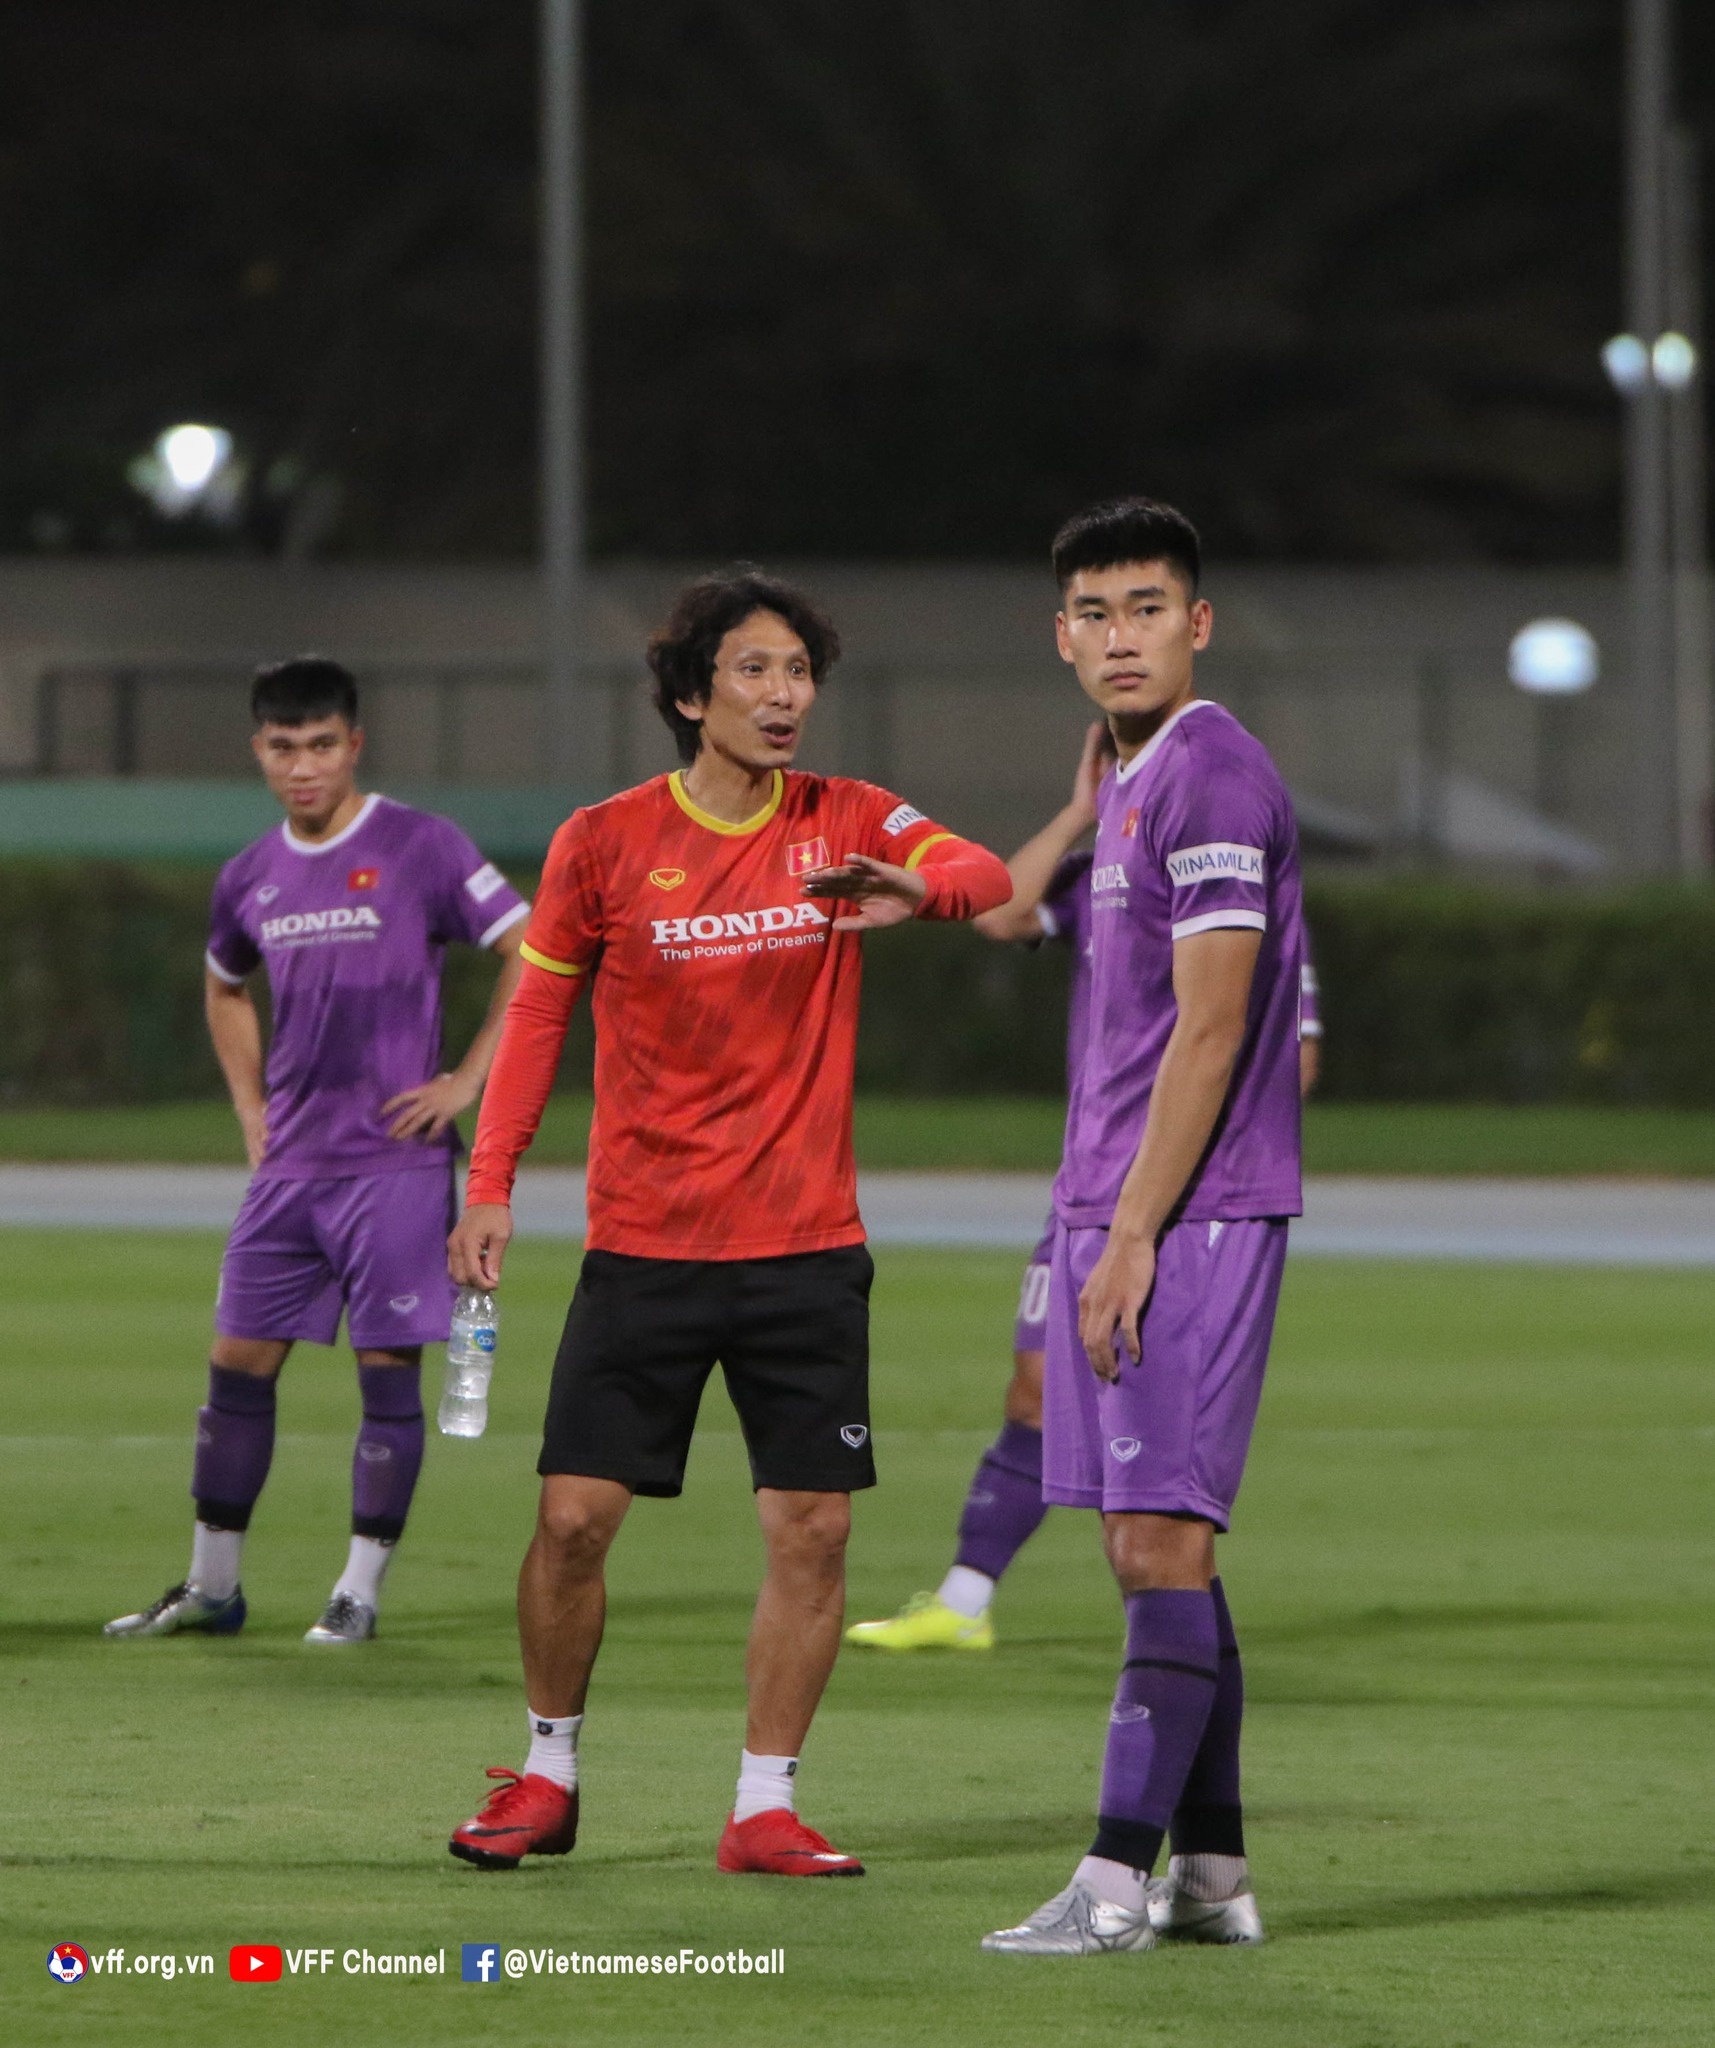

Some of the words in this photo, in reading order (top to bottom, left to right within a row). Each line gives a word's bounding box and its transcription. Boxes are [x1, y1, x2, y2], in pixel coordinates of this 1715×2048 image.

[1169, 851, 1261, 877] VINAMILK
[260, 906, 382, 941] HONDA
[652, 902, 829, 944] HONDA
[660, 947, 691, 962] The
[694, 941, 744, 959] Power
[746, 939, 765, 953] of
[767, 931, 825, 950] Dreams
